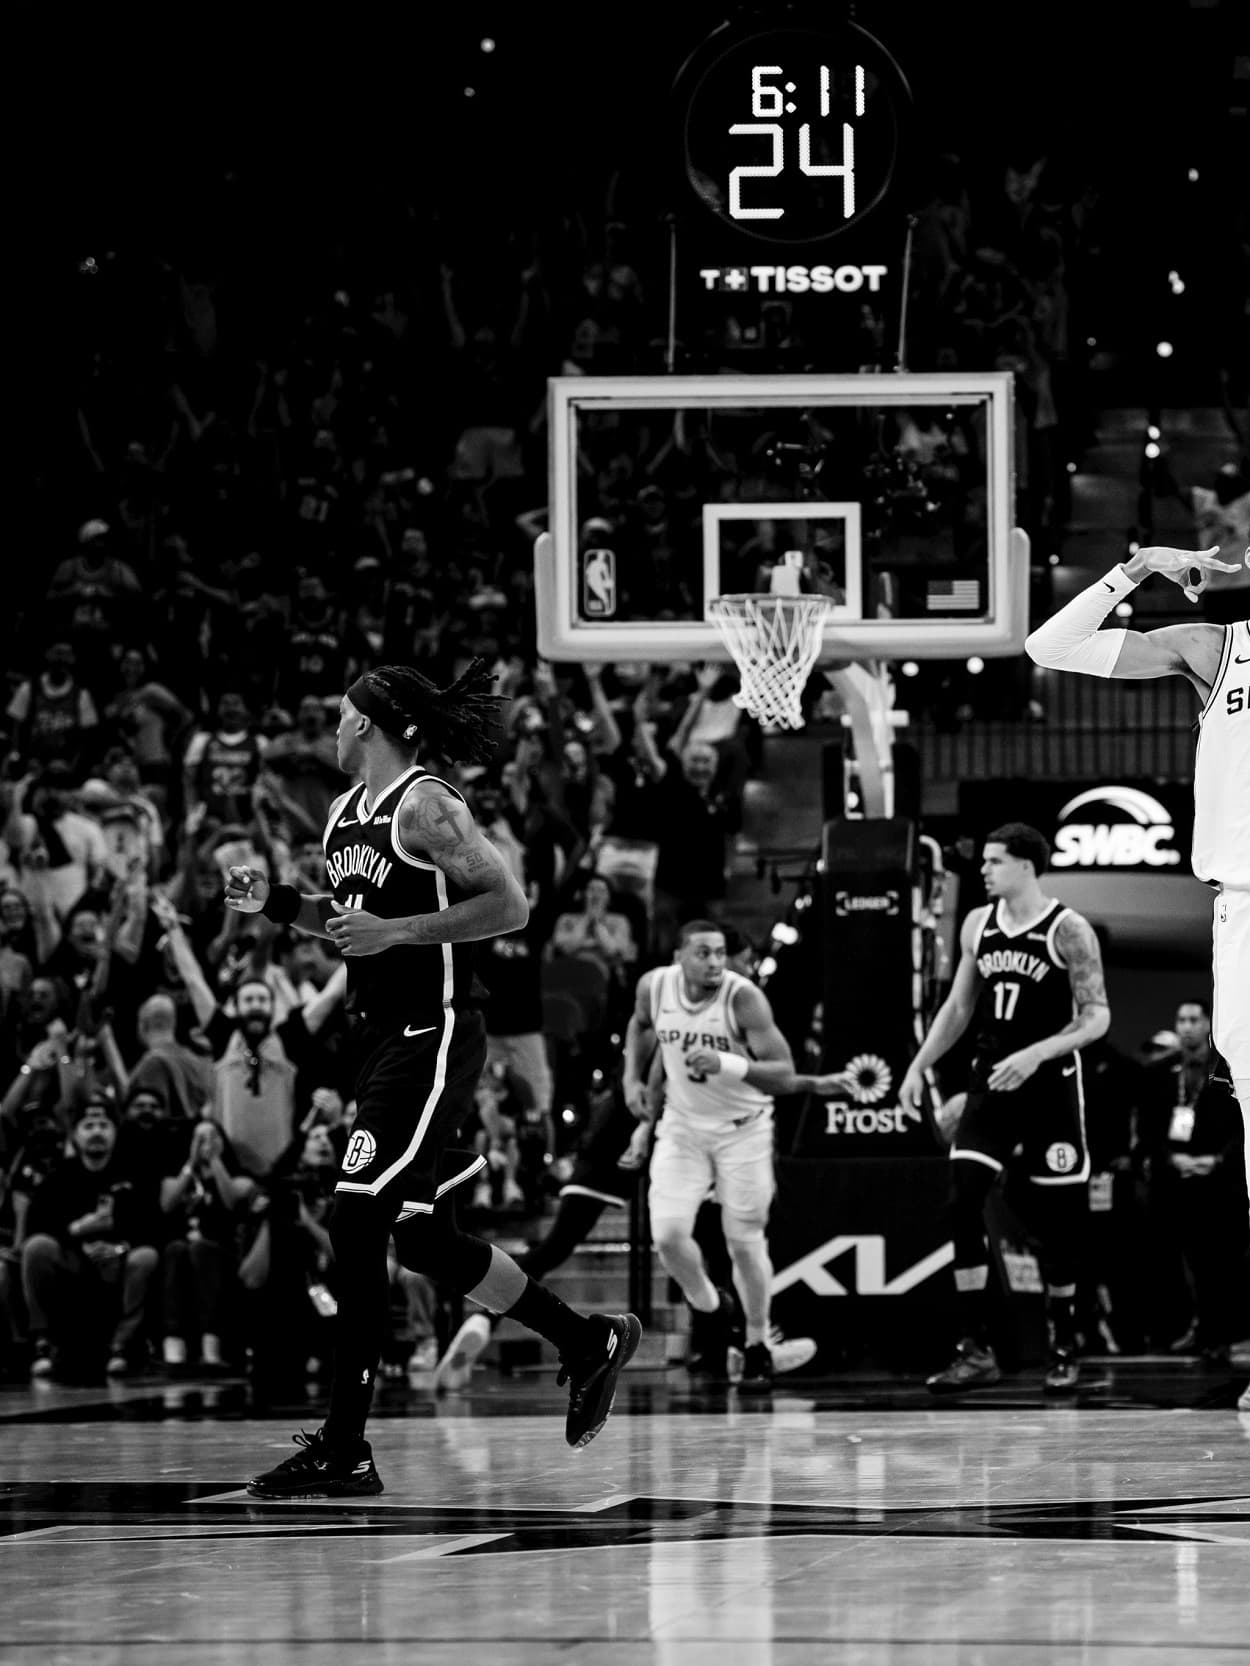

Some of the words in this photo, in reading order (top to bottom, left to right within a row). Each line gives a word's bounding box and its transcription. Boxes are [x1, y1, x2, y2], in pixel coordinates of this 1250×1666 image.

[751, 64, 866, 118] 6:11
[727, 122, 857, 220] 24
[750, 264, 888, 293] TISSOT
[326, 843, 393, 889] BROOKLYN
[976, 949, 1051, 983] BROOKLYN
[993, 981, 1021, 1022] 17
[658, 1029, 731, 1052] SPURS
[825, 1102, 908, 1134] Frost
